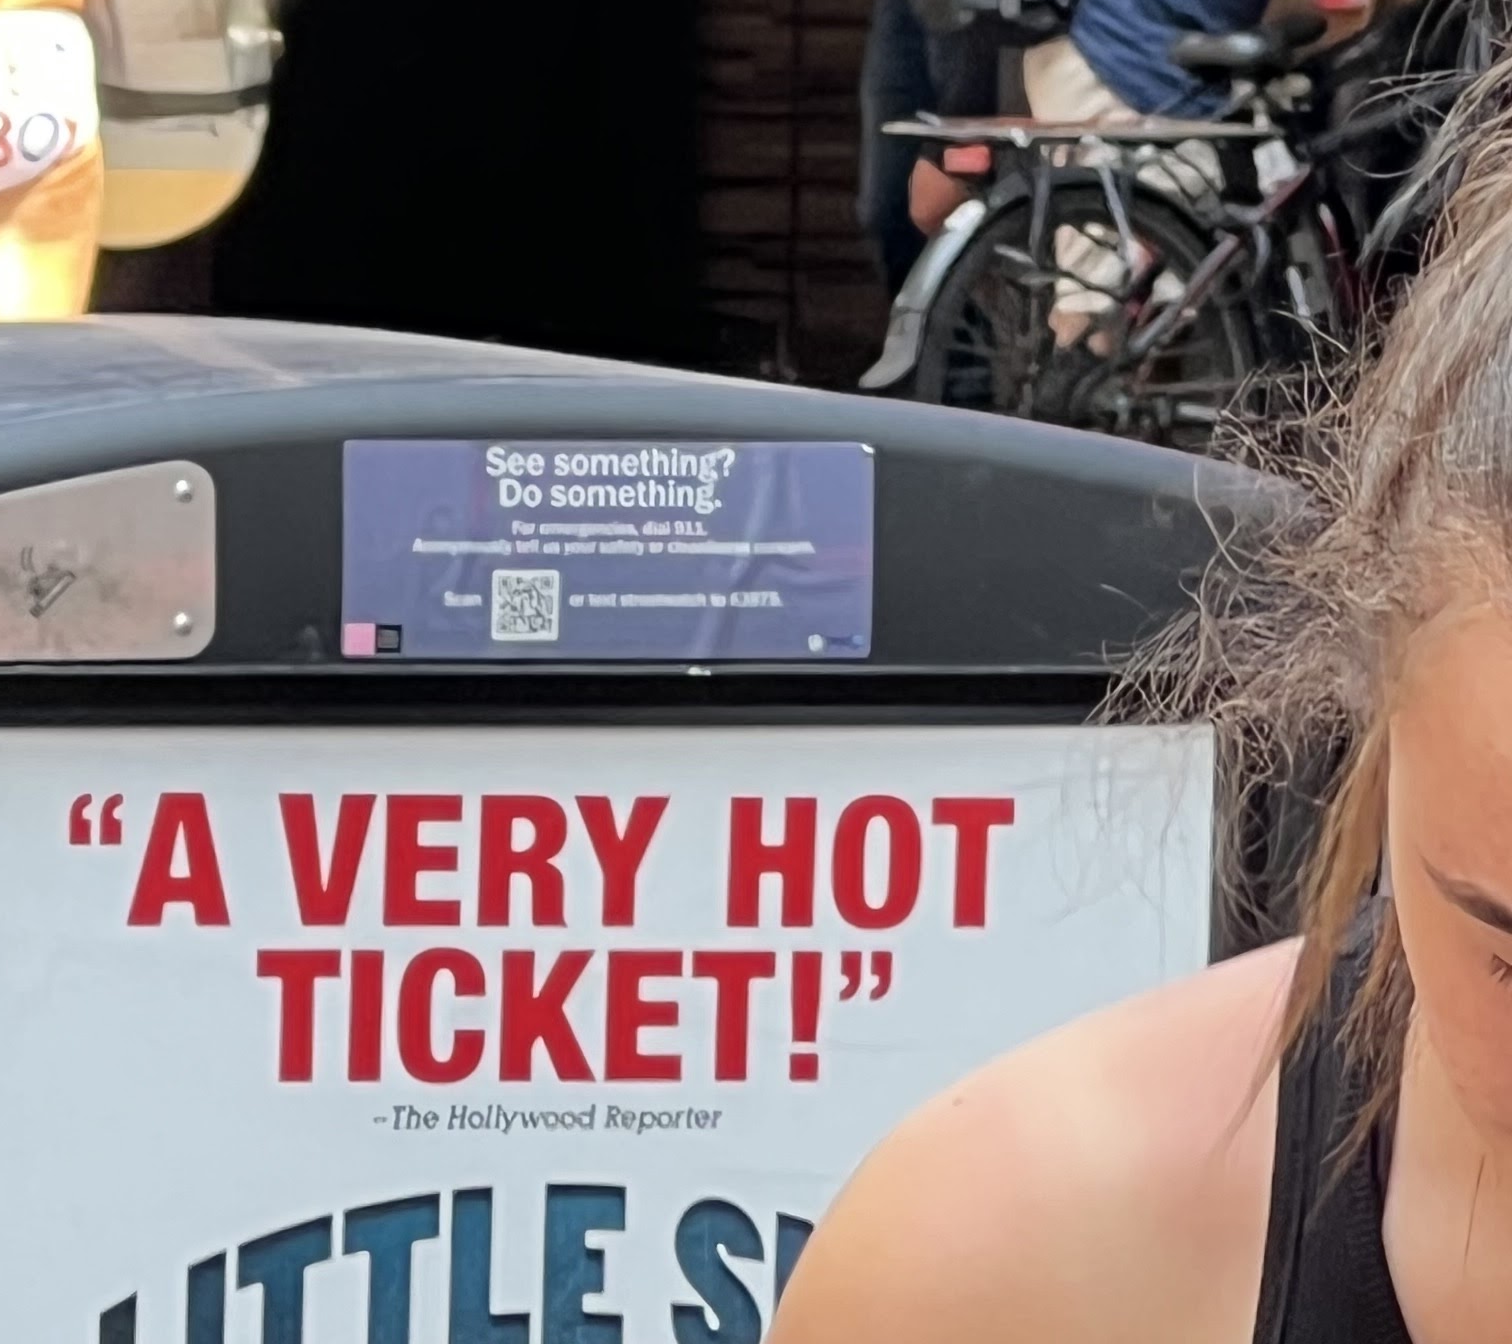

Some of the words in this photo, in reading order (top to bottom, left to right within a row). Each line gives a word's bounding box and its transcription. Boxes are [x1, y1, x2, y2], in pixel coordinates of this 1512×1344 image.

[486, 446, 545, 477] See
[554, 448, 736, 483] something?
[499, 478, 543, 508] Do
[550, 479, 723, 515] something.
[279, 792, 670, 928] VERY
[726, 795, 1015, 930] HOT
[256, 947, 893, 1084] TICKET!”
[446, 1104, 597, 1135] Hollywood
[603, 1105, 723, 1136] Reporter
[99, 1183, 627, 1344] ITTLE
